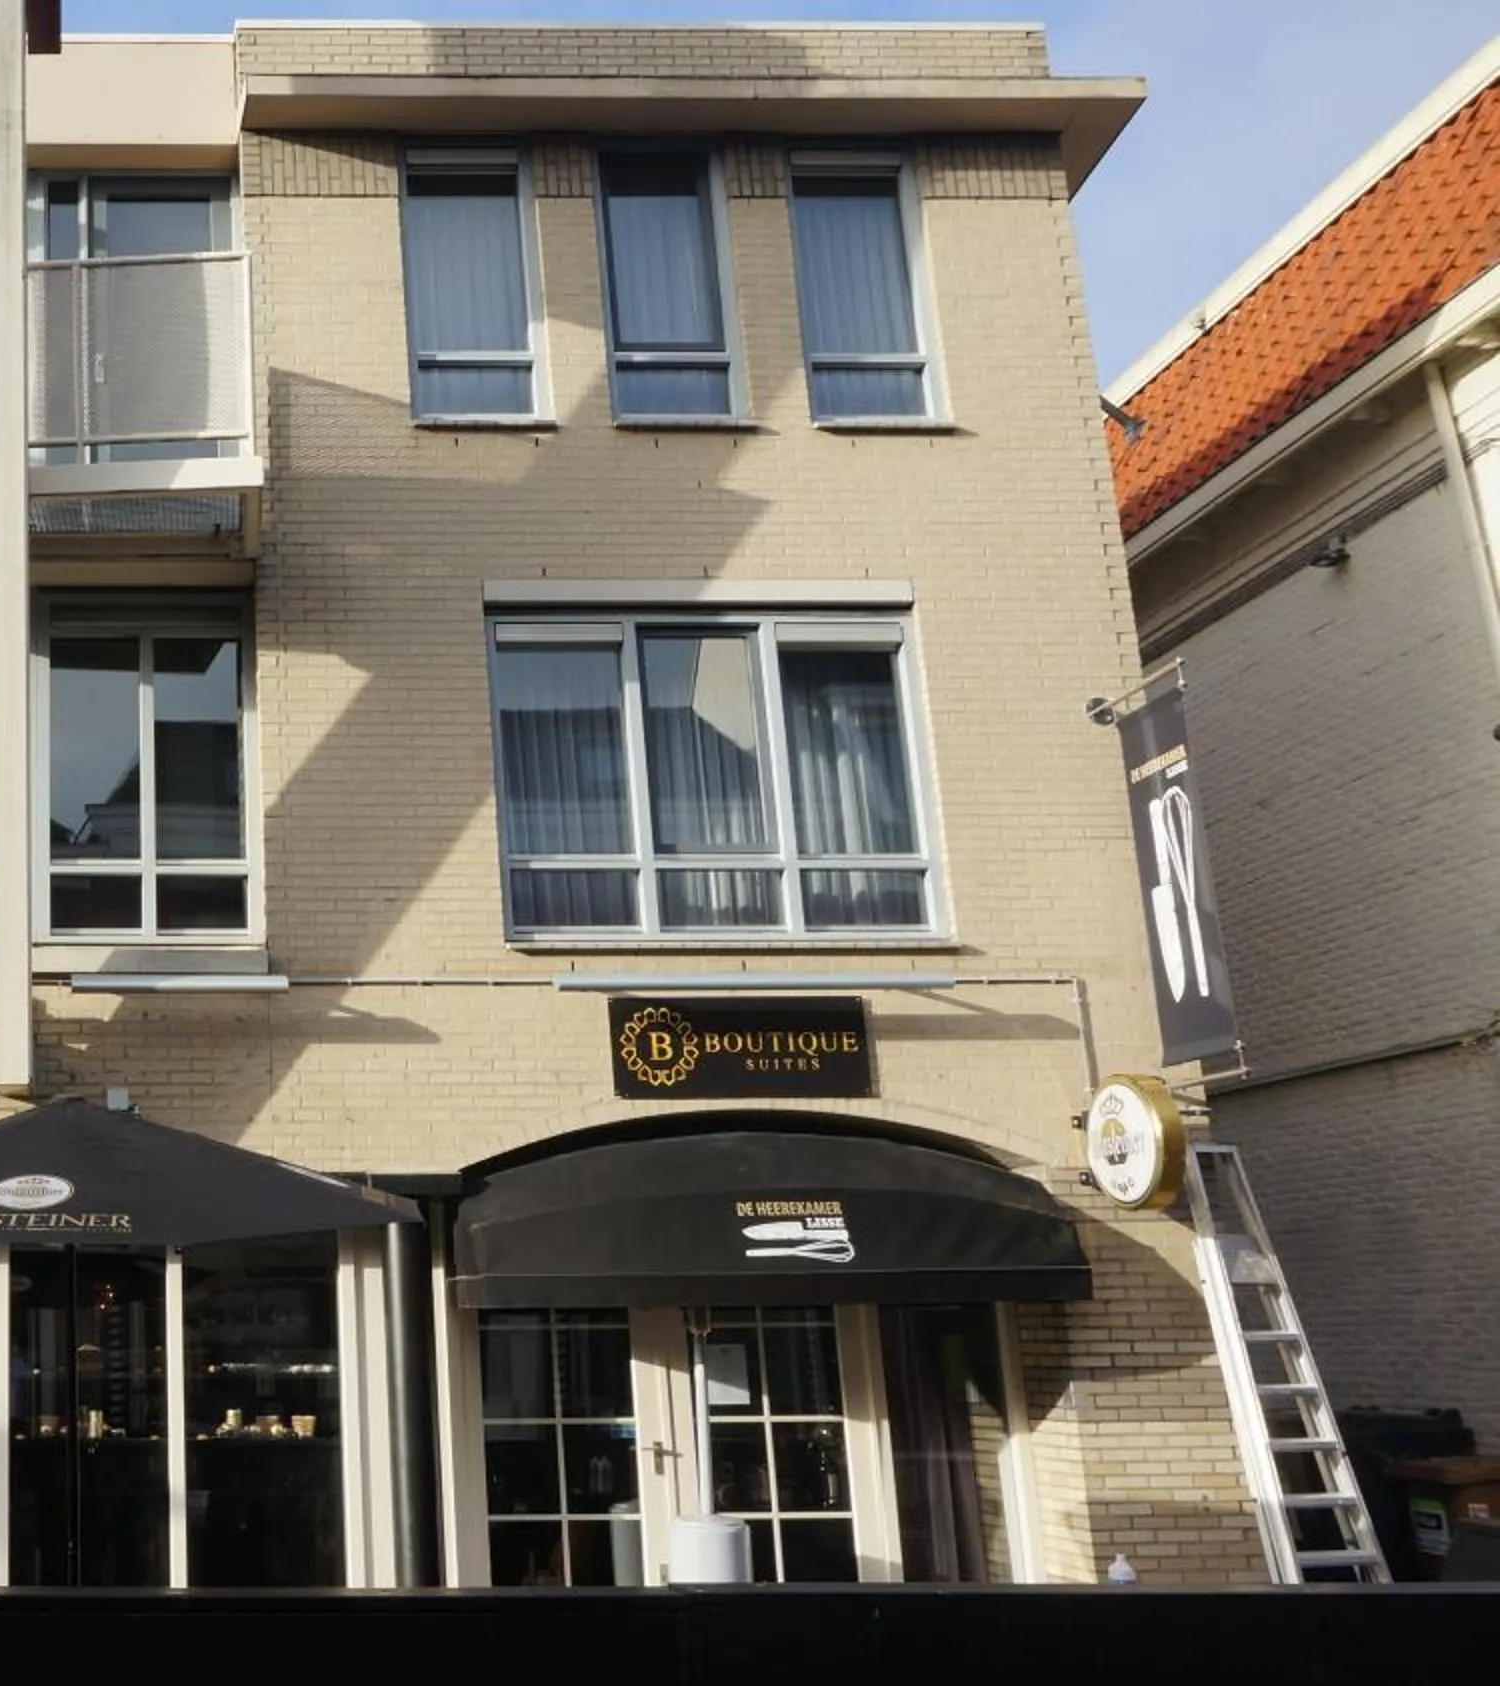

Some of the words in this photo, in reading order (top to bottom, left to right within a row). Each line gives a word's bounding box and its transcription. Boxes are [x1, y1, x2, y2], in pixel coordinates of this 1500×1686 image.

[648, 1031, 674, 1061] B
[704, 1031, 860, 1056] BOUTIQUE
[745, 1057, 822, 1072] SUITES
[736, 1201, 755, 1217] DE
